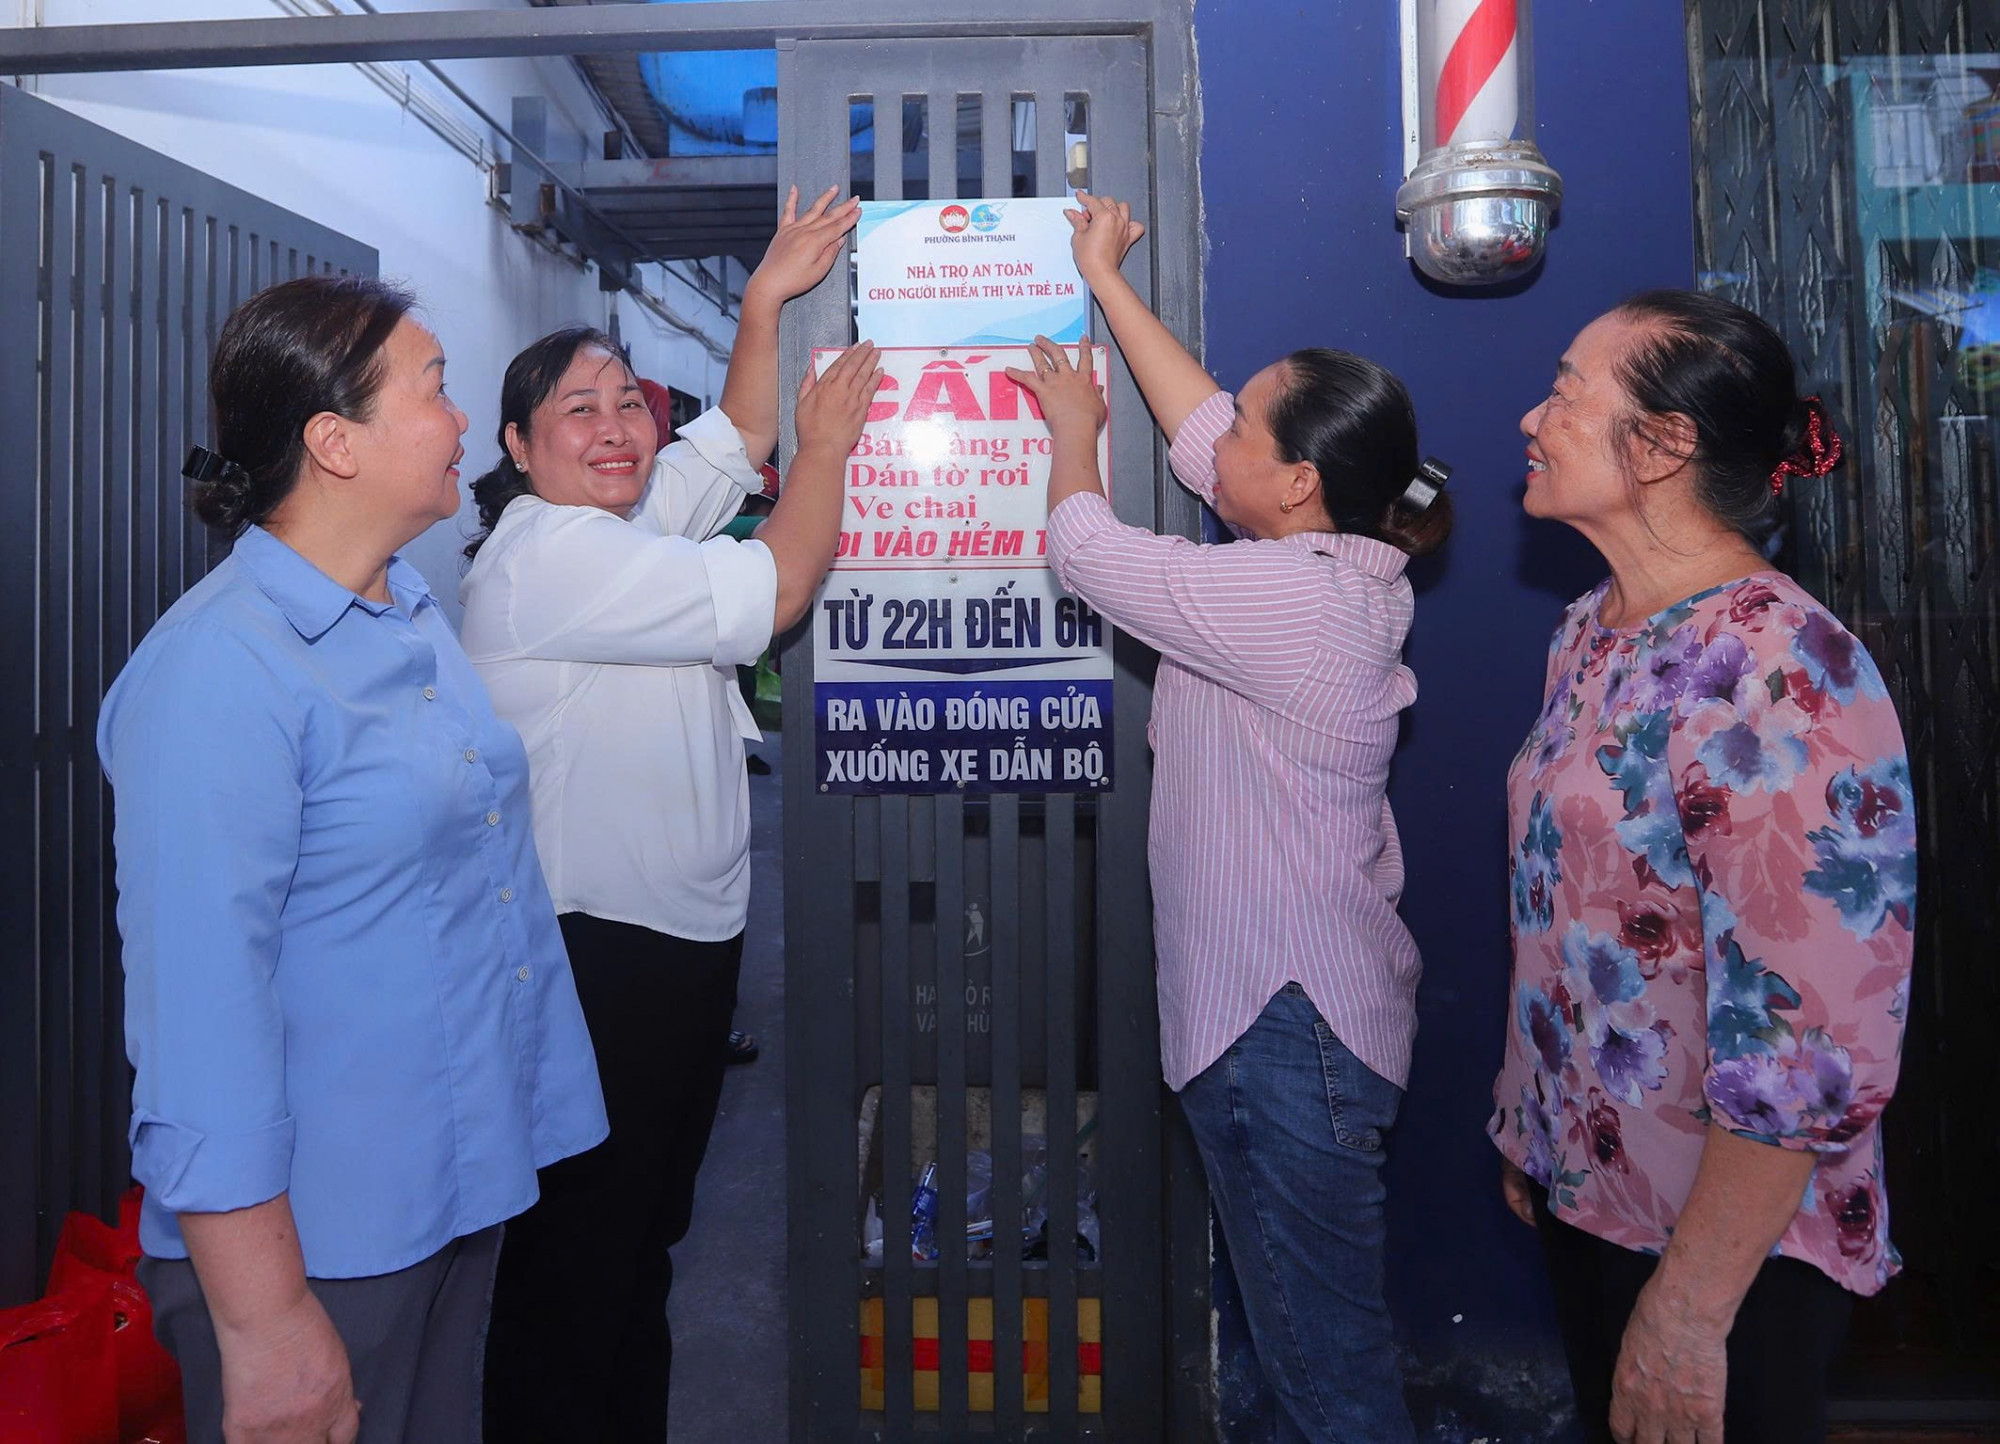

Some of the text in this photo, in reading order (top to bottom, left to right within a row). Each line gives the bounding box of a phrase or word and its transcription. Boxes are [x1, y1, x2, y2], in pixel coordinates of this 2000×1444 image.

[962, 233, 983, 243] BÌNH
[985, 233, 1016, 244] THẠNH
[906, 260, 1033, 281] NHÀ TRỌ AN TOÀN
[868, 280, 1075, 300] CHO NGƯỜI KHIẾM THỊ VÀ TRẺ EM
[949, 431, 1010, 462] àng
[849, 462, 1030, 488] Dán tờ rơi
[849, 494, 977, 519] Ve chai
[874, 524, 938, 558] VÀO
[949, 521, 1024, 556] HẺM
[823, 580, 1102, 650] TỪ 22H ĐẾN 6H
[827, 685, 1102, 731] RA VÀO ĐÓNG CỬA
[826, 736, 1104, 787] XUỐNG XE DẪN BỘ
